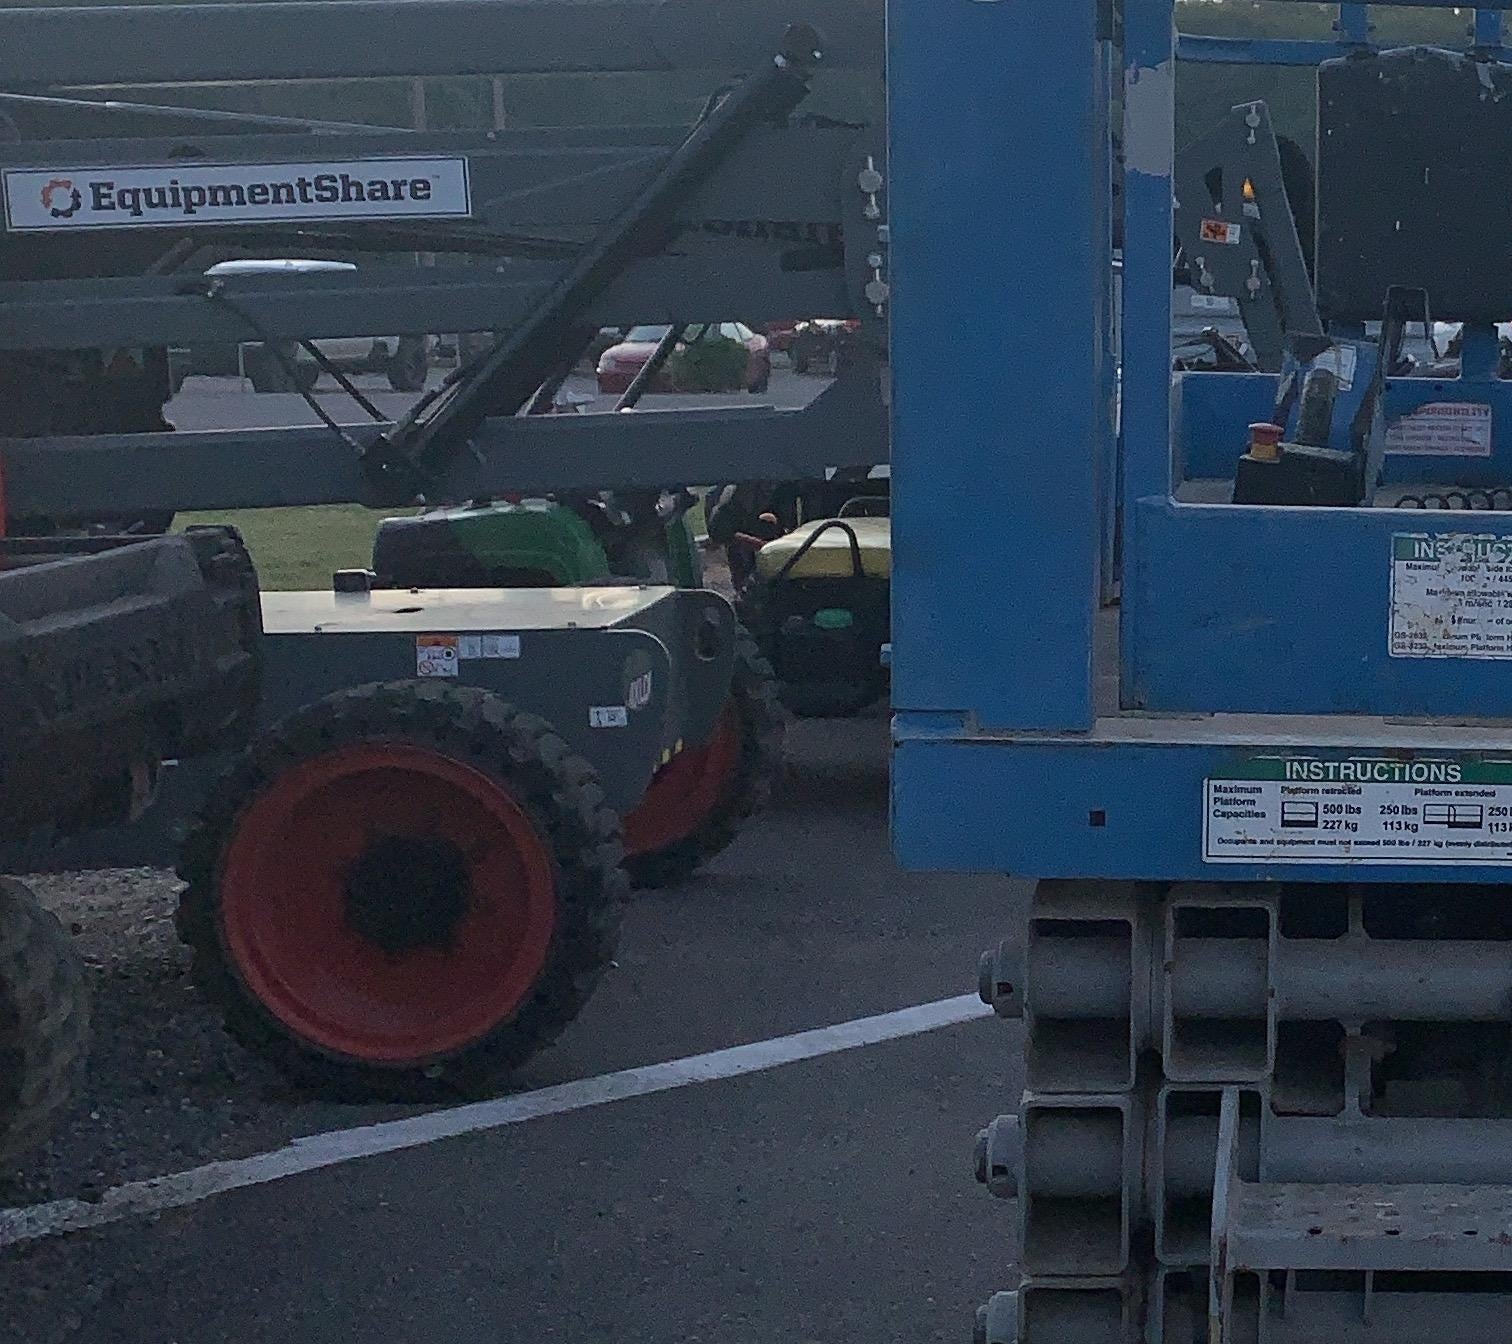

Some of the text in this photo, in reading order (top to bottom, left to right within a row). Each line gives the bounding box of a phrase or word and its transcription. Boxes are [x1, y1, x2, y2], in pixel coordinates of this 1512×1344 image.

[89, 174, 432, 216] EquipmentShare
[1285, 760, 1462, 783] INSTRUCTIONS
[1213, 785, 1497, 798] Maximum Platform retracted Platform extended
[1213, 796, 1257, 806] Platform
[1212, 808, 1267, 820] Capacities
[1322, 803, 1343, 815] 500
[1345, 803, 1362, 815] lbs
[1379, 804, 1400, 815] 250
[1401, 805, 1418, 816] lbs
[1488, 806, 1508, 817] 250
[1322, 819, 1343, 830] 227
[1344, 819, 1359, 833] kg
[1382, 821, 1402, 831] 113
[1404, 821, 1419, 834] kg
[1488, 822, 1507, 833] 113
[1217, 836, 1258, 846] Occupants
[1259, 837, 1274, 845] and
[1276, 838, 1316, 847] equipment
[1317, 838, 1337, 846] must
[1338, 838, 1352, 846] not
[1382, 839, 1397, 847] 500
[1417, 839, 1431, 848] 227
